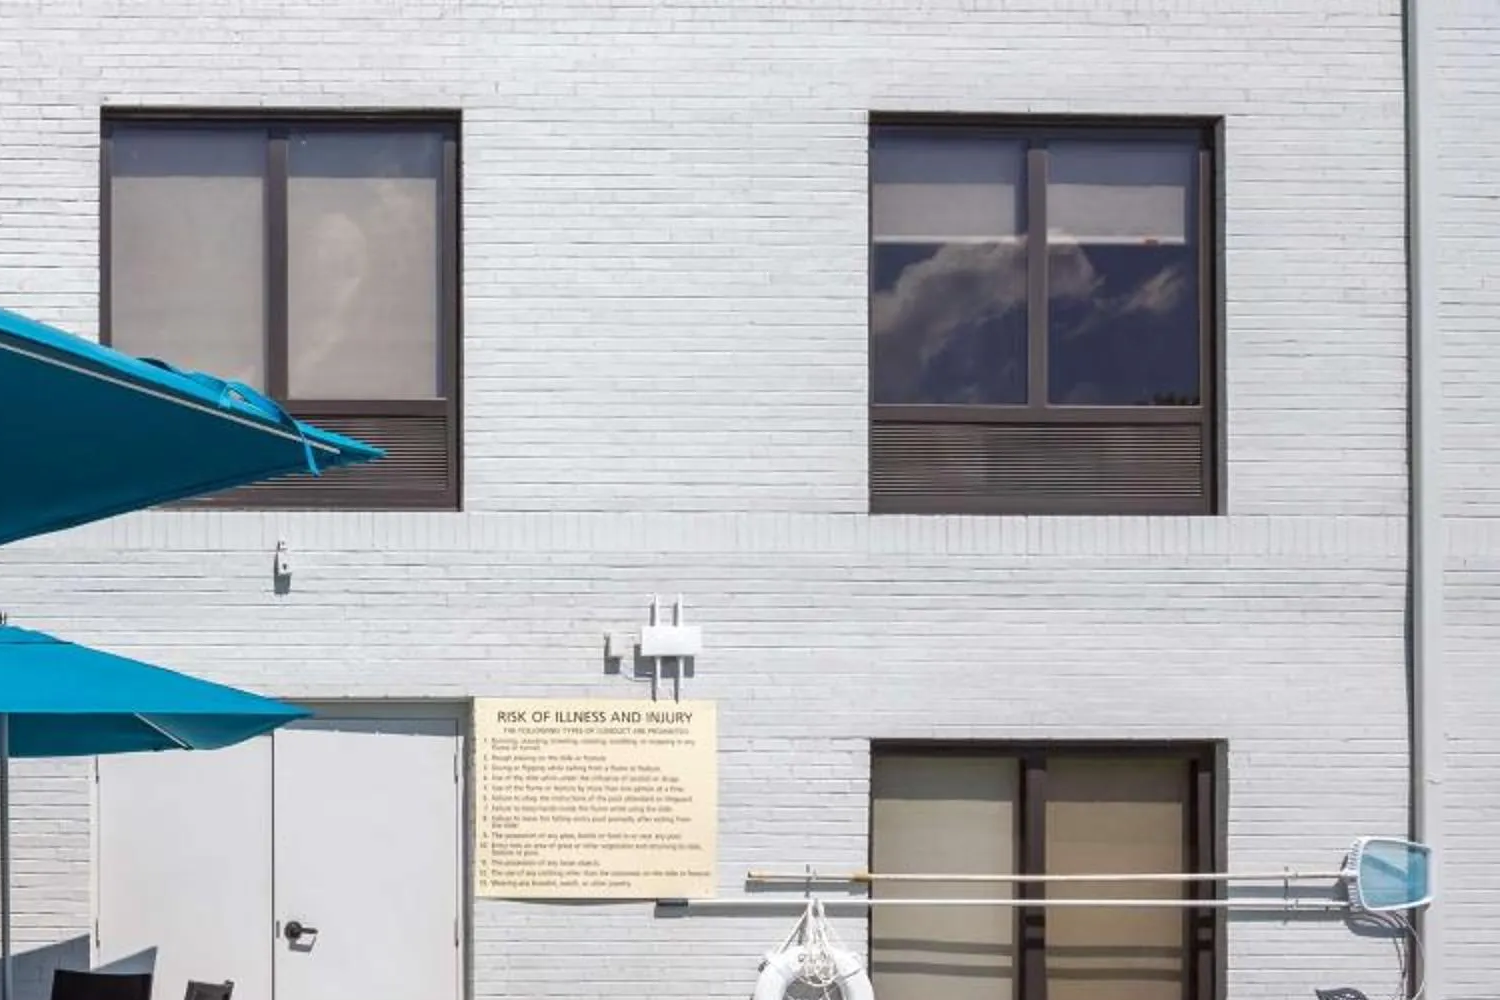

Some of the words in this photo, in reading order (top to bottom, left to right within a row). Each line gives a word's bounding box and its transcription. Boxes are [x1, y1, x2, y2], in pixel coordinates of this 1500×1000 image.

[497, 711, 527, 723] RISK
[531, 711, 552, 723] OF
[555, 711, 607, 723] ILLNESS
[610, 711, 642, 723] AND
[645, 711, 693, 724] INJURY
